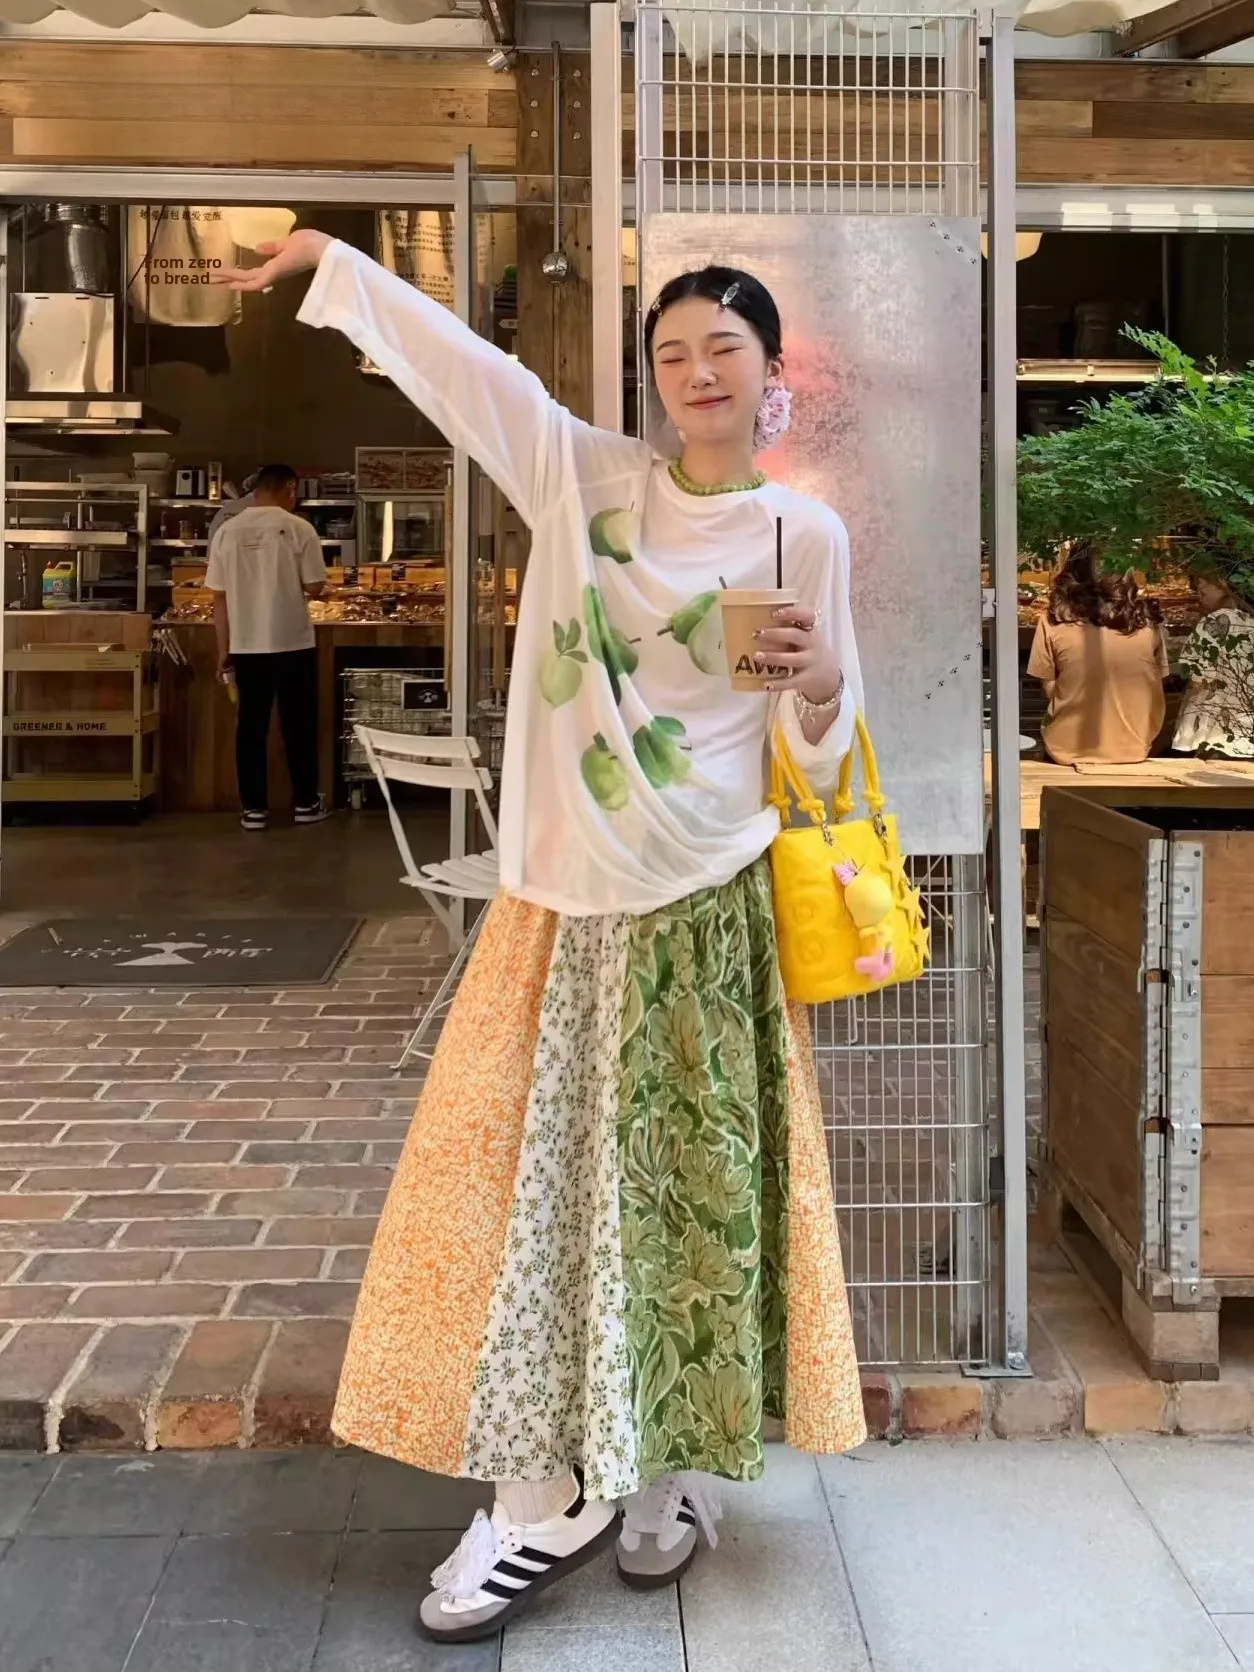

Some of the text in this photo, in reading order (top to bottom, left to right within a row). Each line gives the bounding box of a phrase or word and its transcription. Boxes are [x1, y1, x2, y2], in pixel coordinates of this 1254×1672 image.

[145, 257, 222, 269] From zero
[144, 272, 210, 285] to bread
[13, 722, 107, 731] GREENER & HOME
